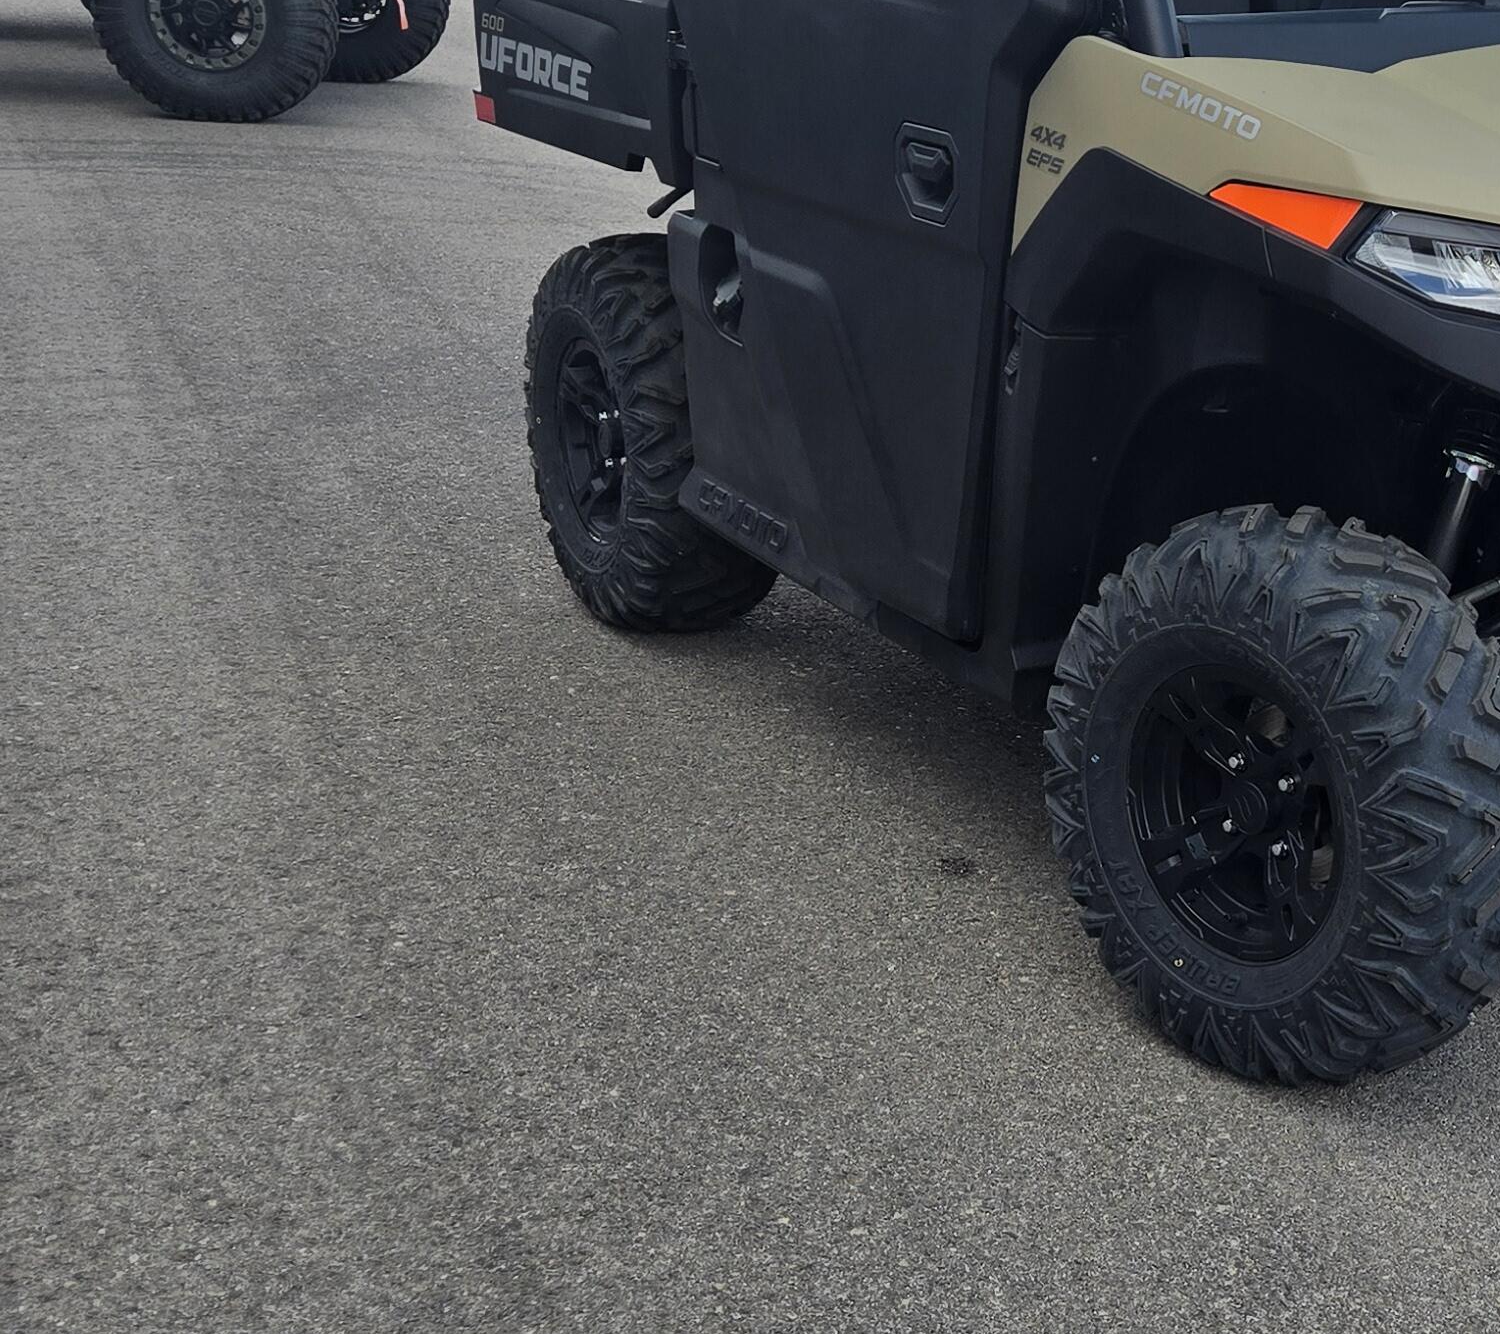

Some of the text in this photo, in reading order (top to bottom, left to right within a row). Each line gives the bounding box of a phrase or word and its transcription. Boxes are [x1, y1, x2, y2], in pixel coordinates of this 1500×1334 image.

[481, 13, 505, 32] 600
[480, 32, 592, 101] UFORCE
[1139, 71, 1262, 141] CFMOTO
[1026, 148, 1065, 175] EPS
[1030, 125, 1067, 151] 4X4
[699, 478, 788, 554] CFMOTO
